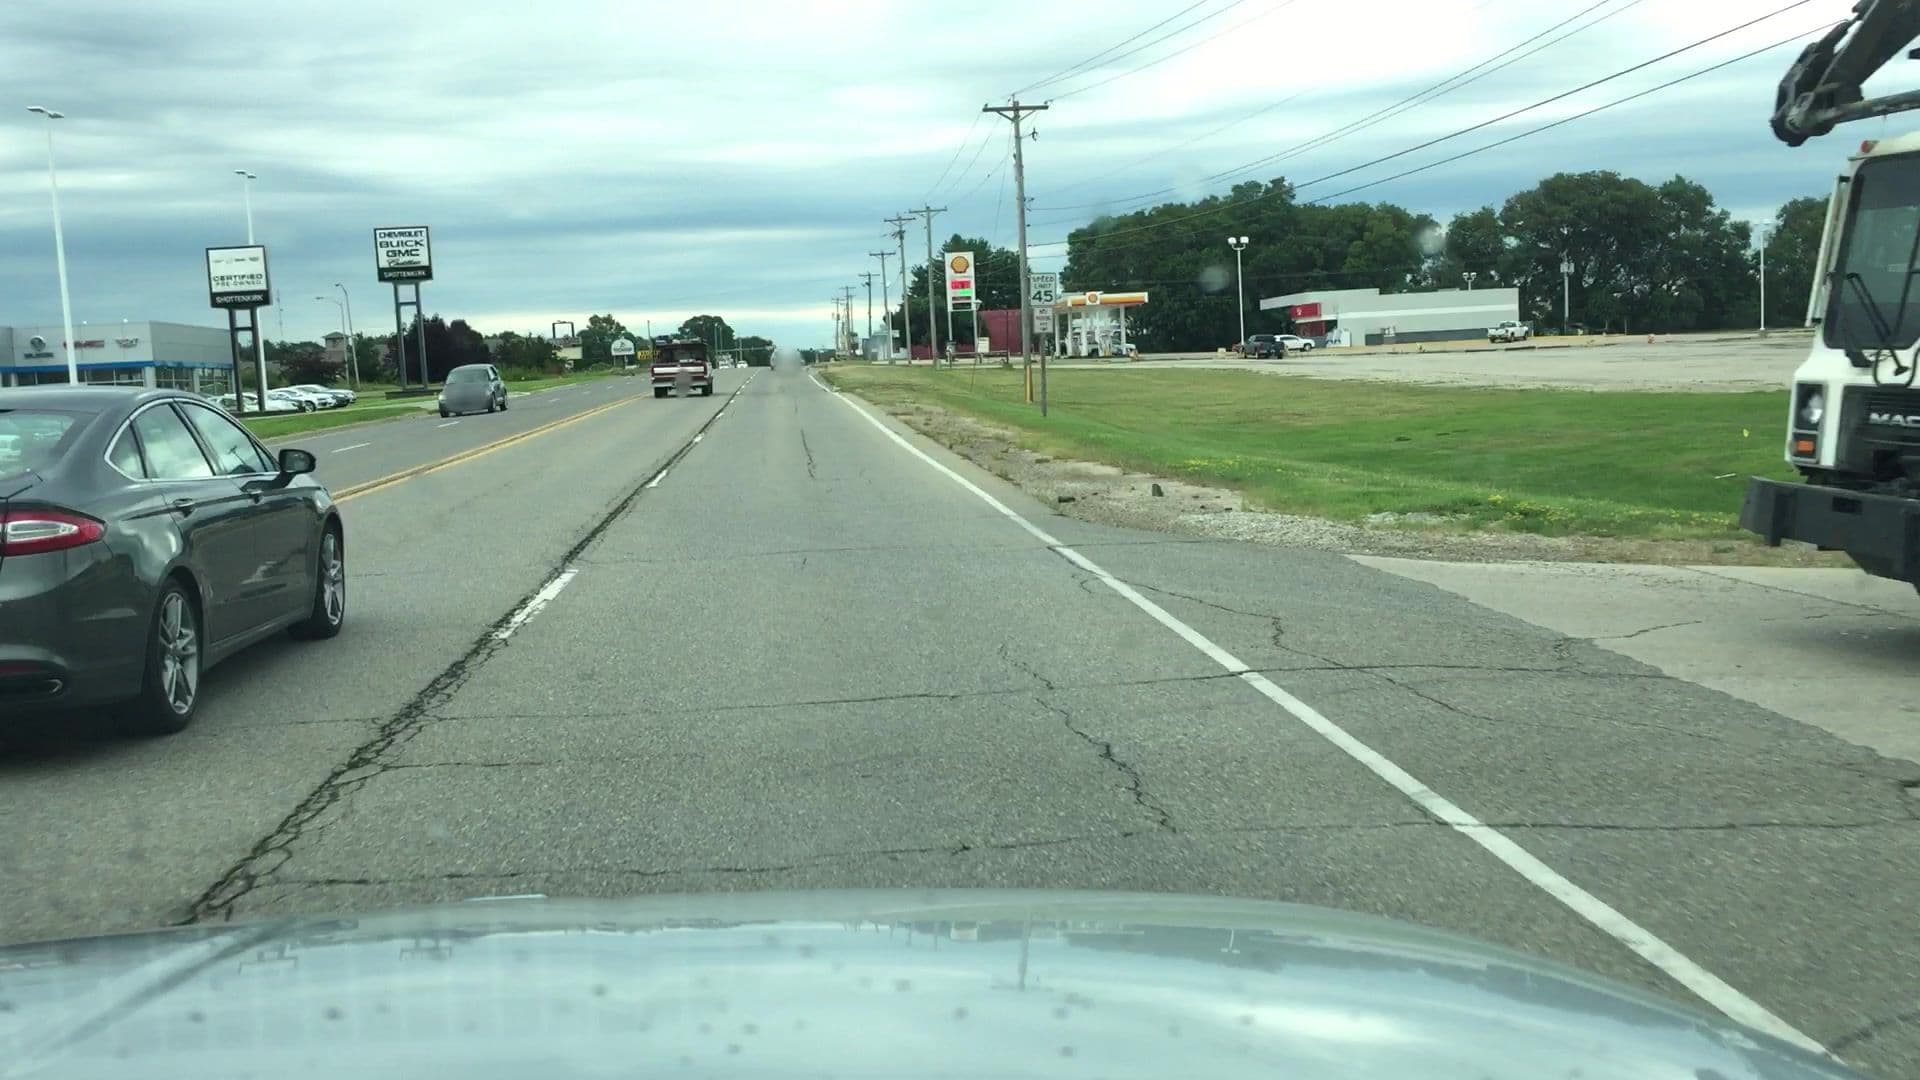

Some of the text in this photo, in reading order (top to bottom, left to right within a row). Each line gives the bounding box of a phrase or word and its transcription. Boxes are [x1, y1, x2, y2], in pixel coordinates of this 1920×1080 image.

[379, 240, 424, 248] BUICK
[386, 249, 420, 257] GMC
[212, 273, 263, 282] CERTIFIED
[1032, 275, 1055, 283] SPEED
[1031, 290, 1054, 303] 45
